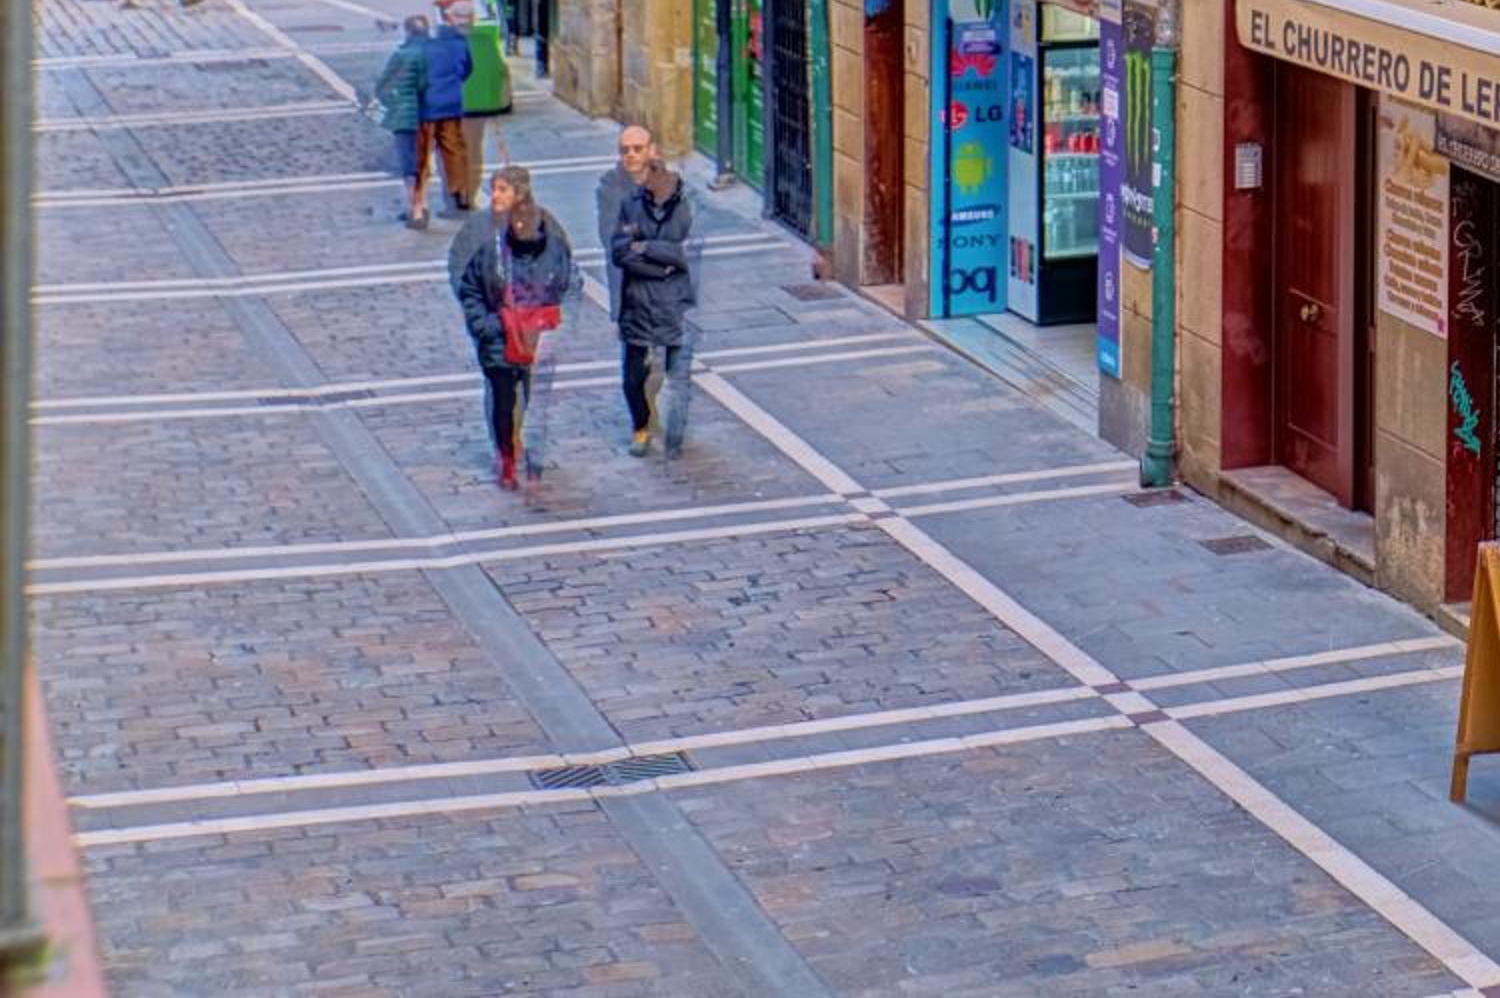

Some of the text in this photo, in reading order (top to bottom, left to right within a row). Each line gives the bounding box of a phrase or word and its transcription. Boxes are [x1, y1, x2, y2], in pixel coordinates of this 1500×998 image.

[1250, 9, 1275, 49] EL
[1283, 19, 1411, 93] CHURRERO
[1418, 61, 1452, 107] DE
[974, 106, 1003, 123] LG
